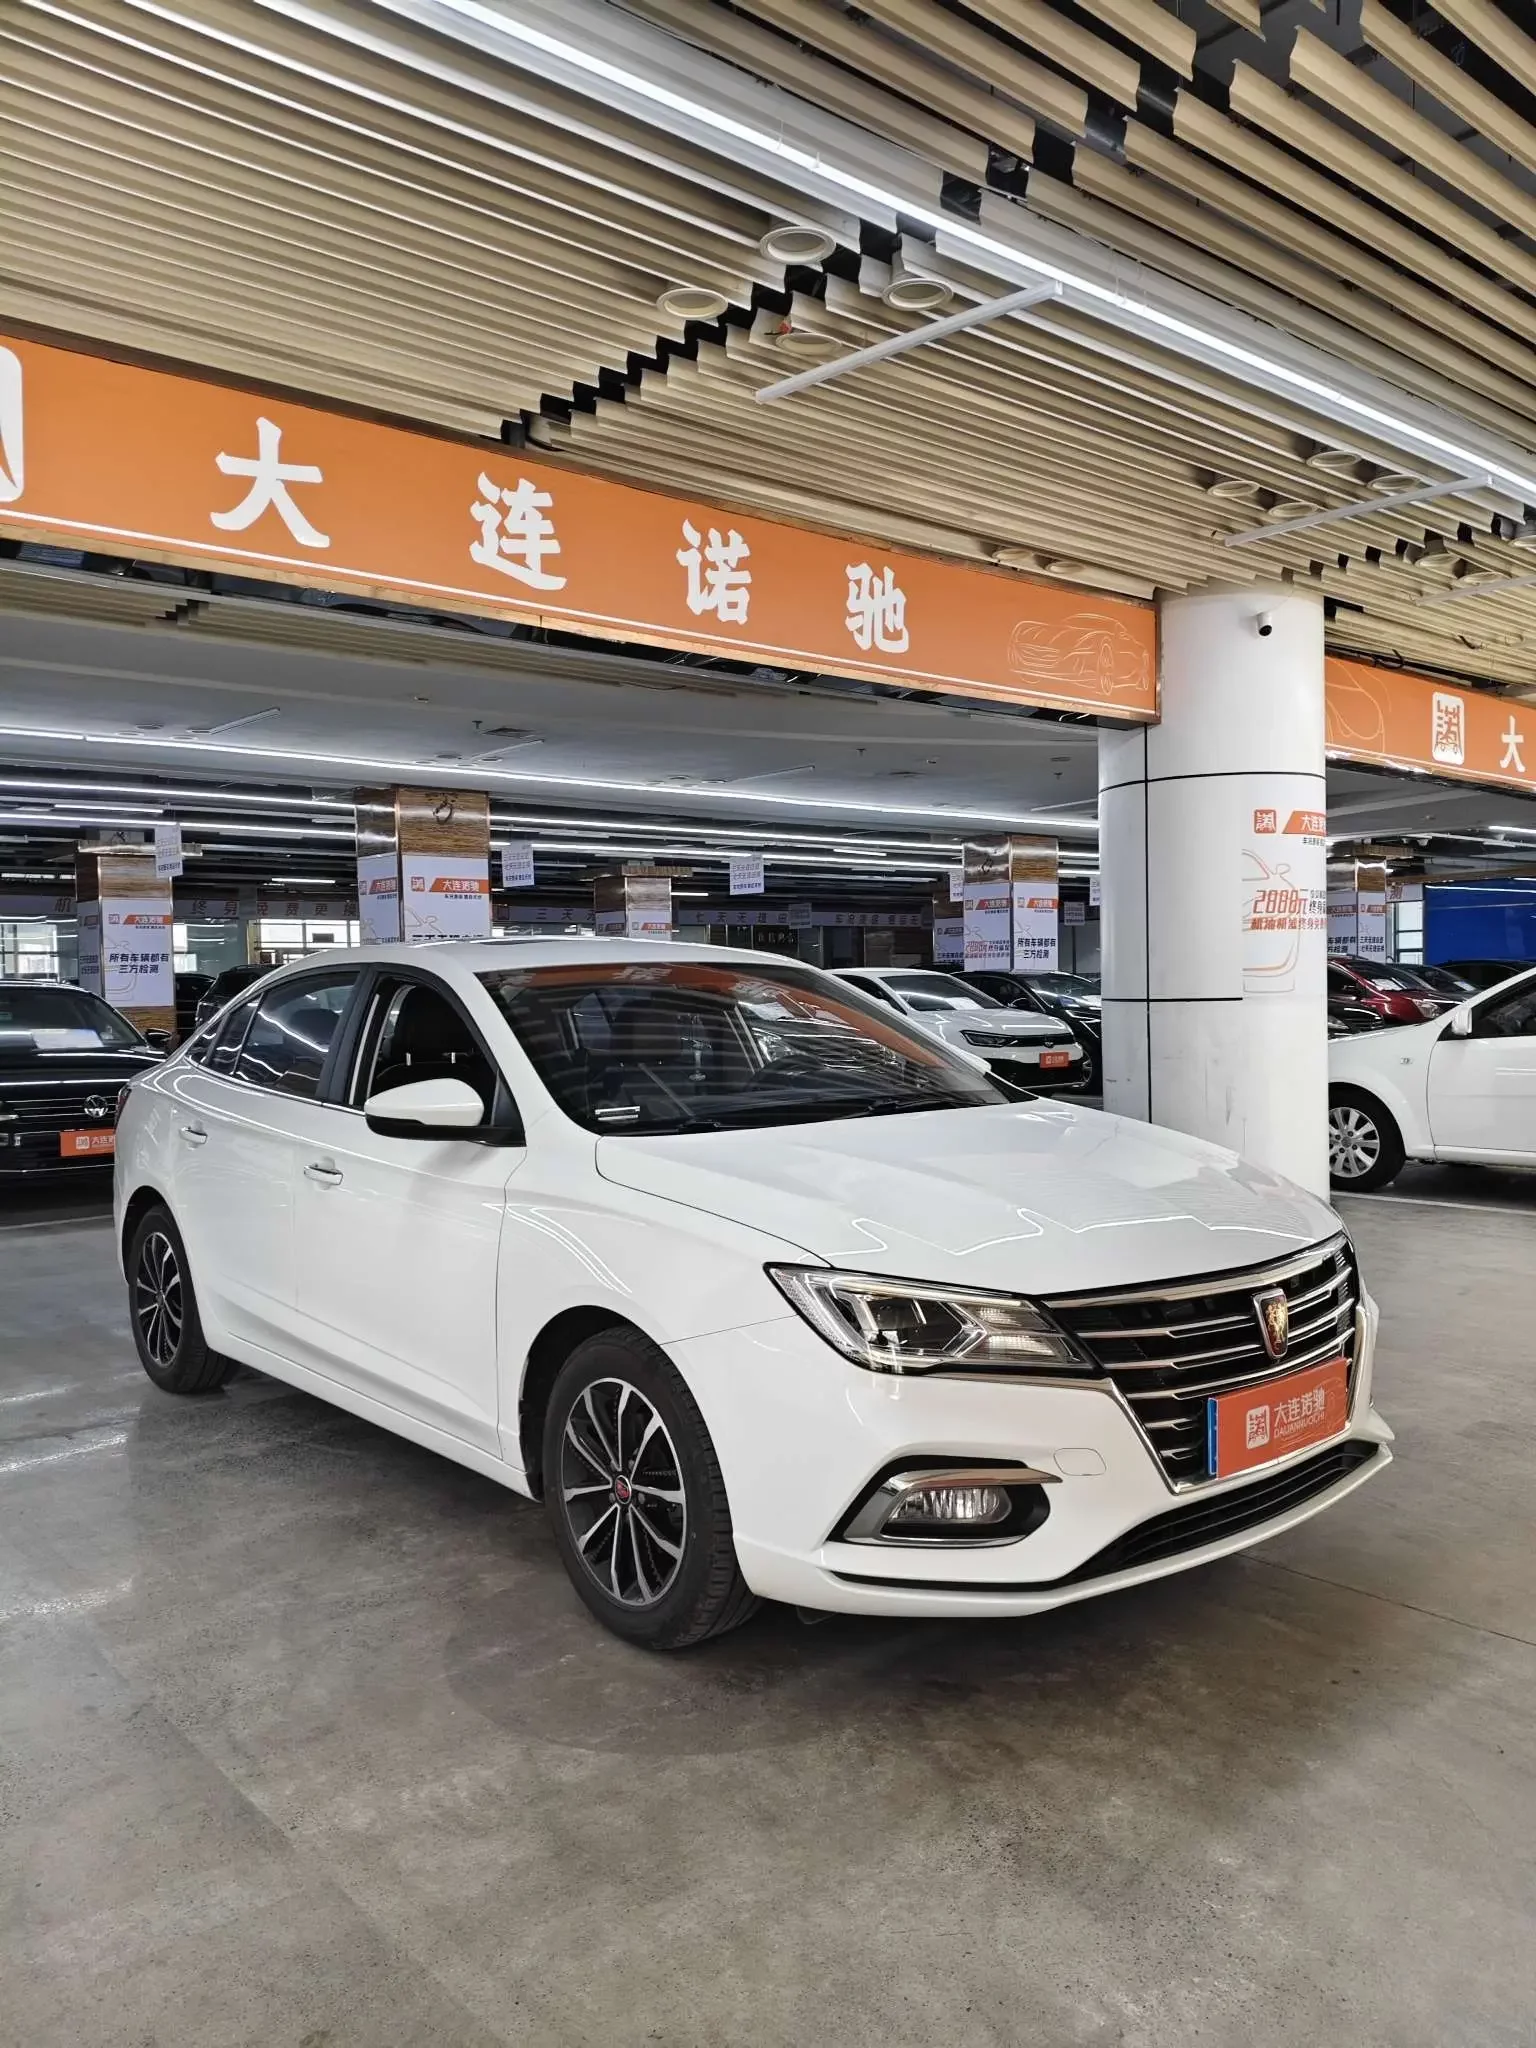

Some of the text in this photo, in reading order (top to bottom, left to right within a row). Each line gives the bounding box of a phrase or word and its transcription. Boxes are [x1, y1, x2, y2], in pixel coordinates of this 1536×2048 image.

[210, 416, 910, 654] 大连诺驰
[1500, 715, 1526, 773] 大
[1017, 938, 1056, 947] 所有车辆都有
[109, 953, 169, 962] 所有车辆都有
[1023, 949, 1050, 959] 三方检测
[119, 964, 159, 974] 三方检测
[1273, 1386, 1326, 1427] 大连诺驰
